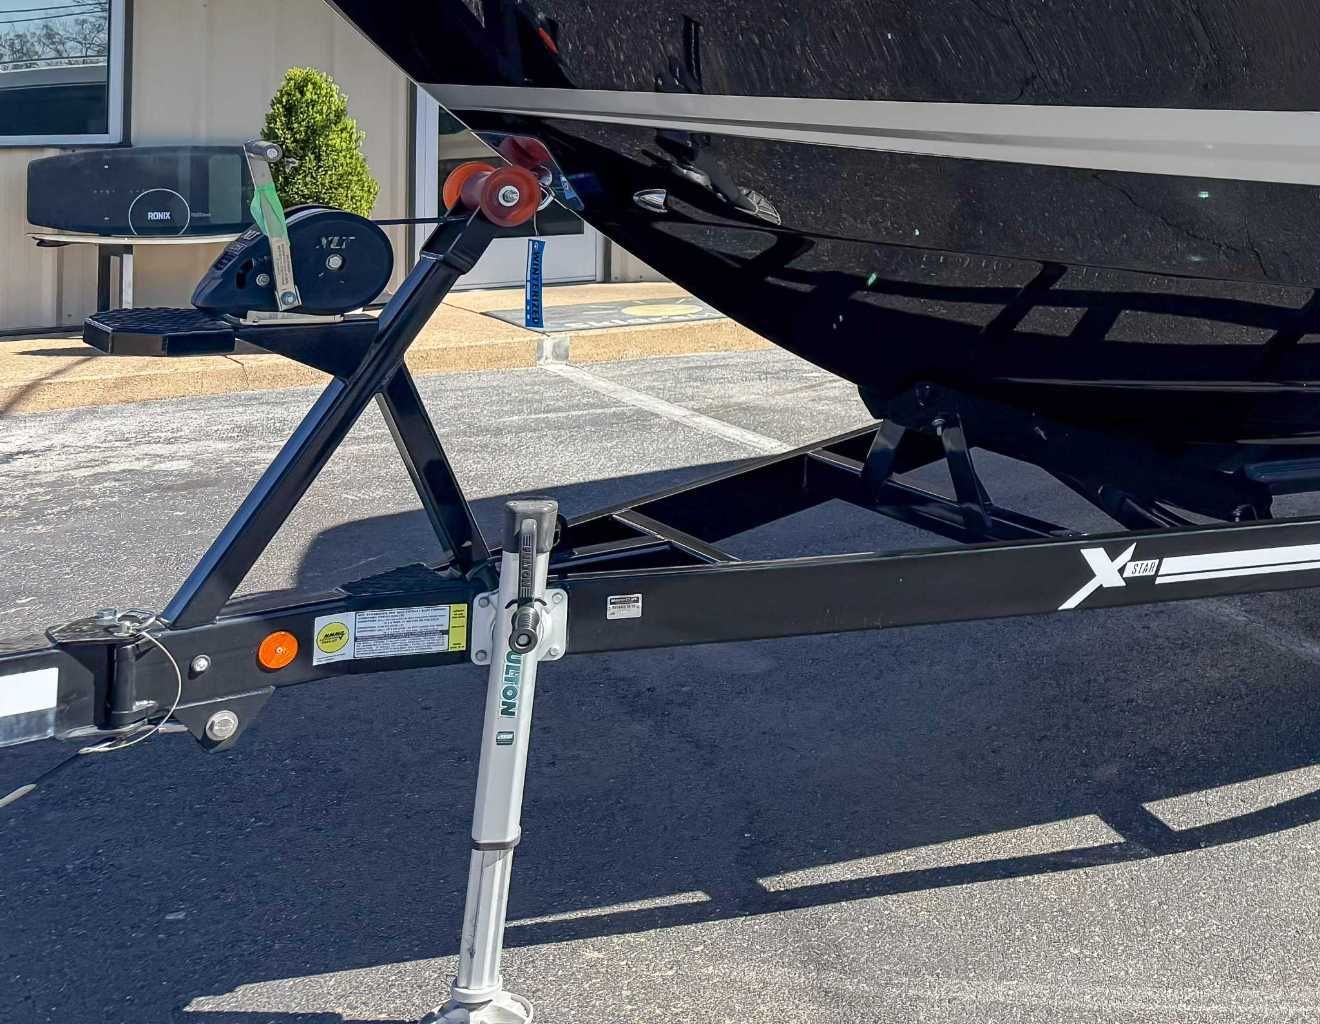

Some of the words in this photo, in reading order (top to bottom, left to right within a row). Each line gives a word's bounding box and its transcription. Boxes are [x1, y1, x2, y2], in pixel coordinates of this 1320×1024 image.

[147, 211, 171, 221] RONIX
[531, 251, 540, 324] WINTERIZED
[1131, 562, 1156, 575] STAR
[500, 650, 522, 717] ULTON
